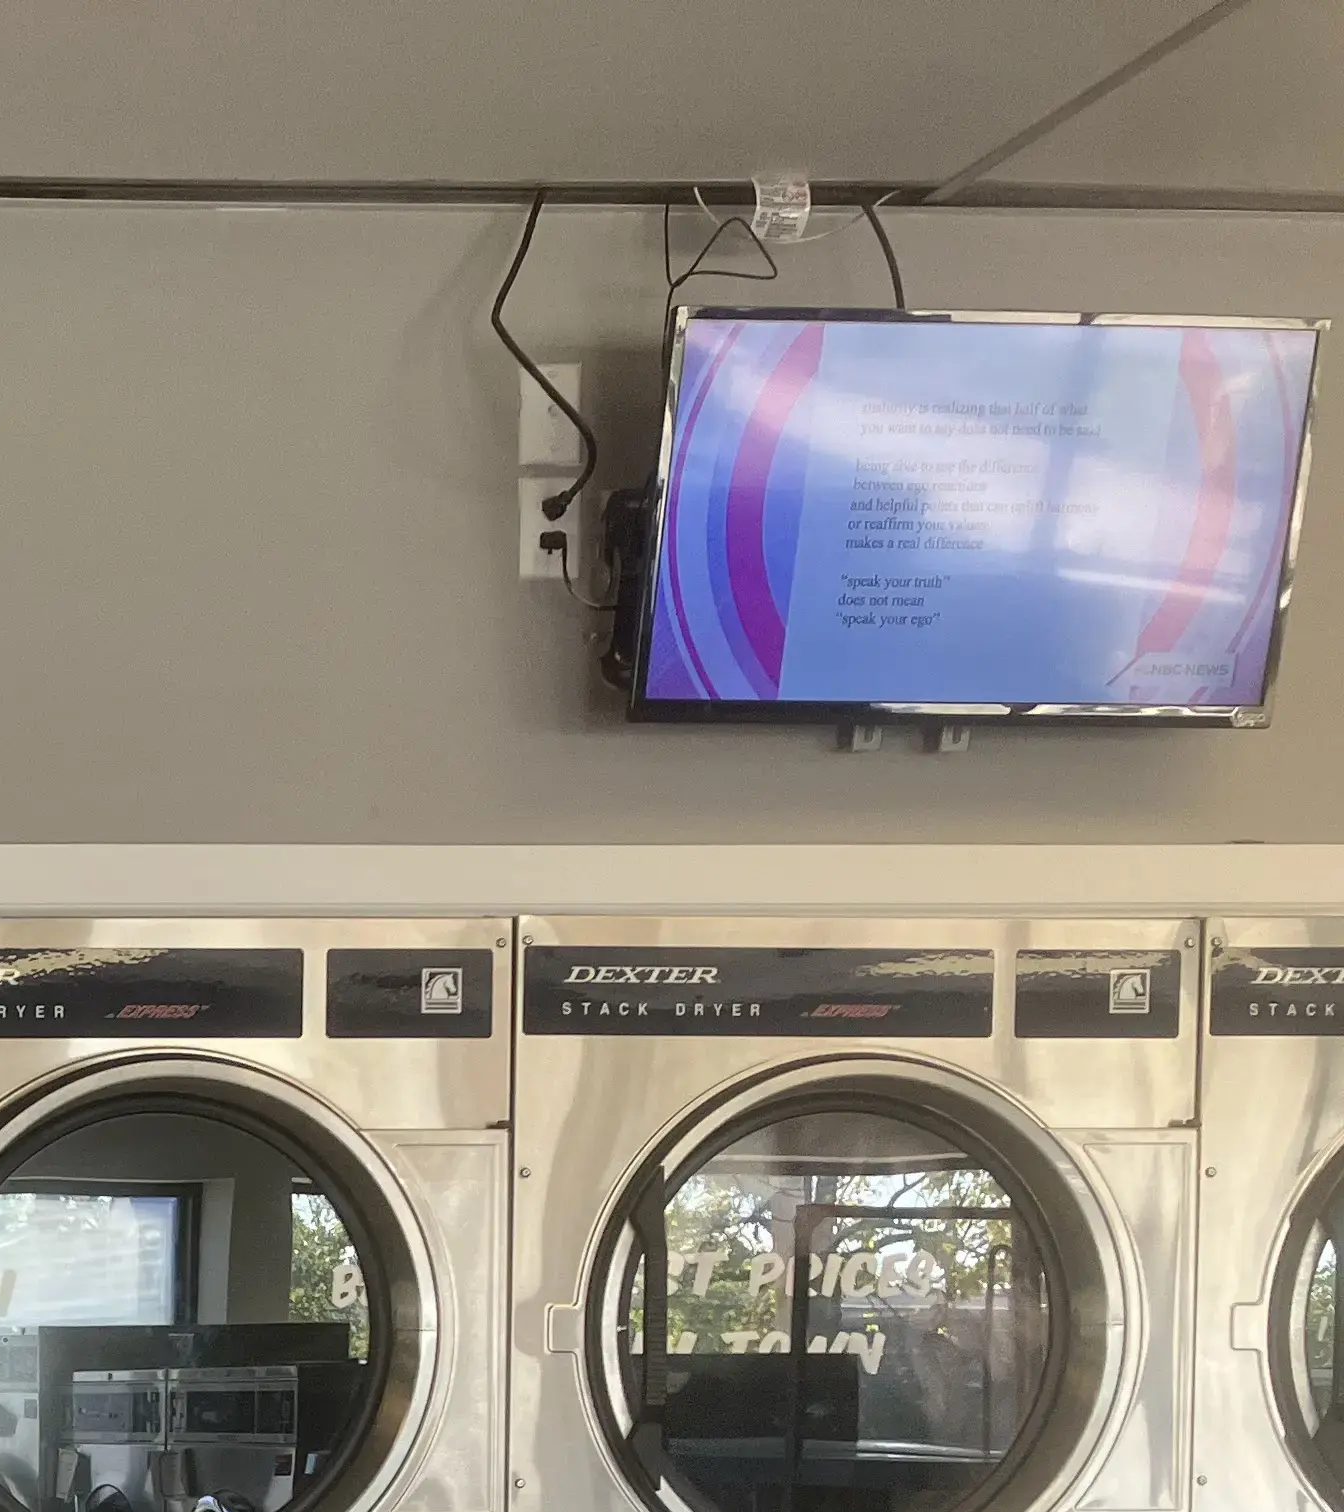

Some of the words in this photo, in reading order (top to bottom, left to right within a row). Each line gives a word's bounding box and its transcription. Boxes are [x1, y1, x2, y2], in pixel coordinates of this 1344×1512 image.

[932, 402, 985, 417] realizing
[989, 402, 1011, 415] that
[1014, 402, 1039, 416] half
[1042, 402, 1056, 416] of
[1058, 402, 1088, 416] what
[861, 424, 883, 437] you
[888, 423, 916, 435] want
[919, 422, 932, 435] to
[990, 422, 1011, 435] not
[1013, 422, 1042, 436] need
[1045, 422, 1056, 435] to
[1059, 422, 1073, 435] be
[856, 458, 889, 475] being
[853, 479, 903, 491] between
[849, 499, 873, 511] and
[875, 498, 918, 513] helpful
[961, 499, 984, 512] that
[847, 519, 861, 530] or
[864, 517, 913, 530] reaffirm
[916, 520, 943, 532] your
[845, 537, 884, 549] makes
[887, 539, 895, 549] a
[898, 537, 921, 549] real
[924, 536, 984, 551] difference
[883, 577, 911, 590] your
[837, 593, 866, 606] does
[869, 594, 889, 606] not
[891, 595, 924, 606] mean
[880, 615, 907, 629] your
[563, 966, 718, 984] DEXTER
[115, 1005, 200, 1019] EXPRESS
[562, 1002, 649, 1016] STACK
[675, 1003, 761, 1017] DRYER
[1249, 1002, 1335, 1016] STACK
